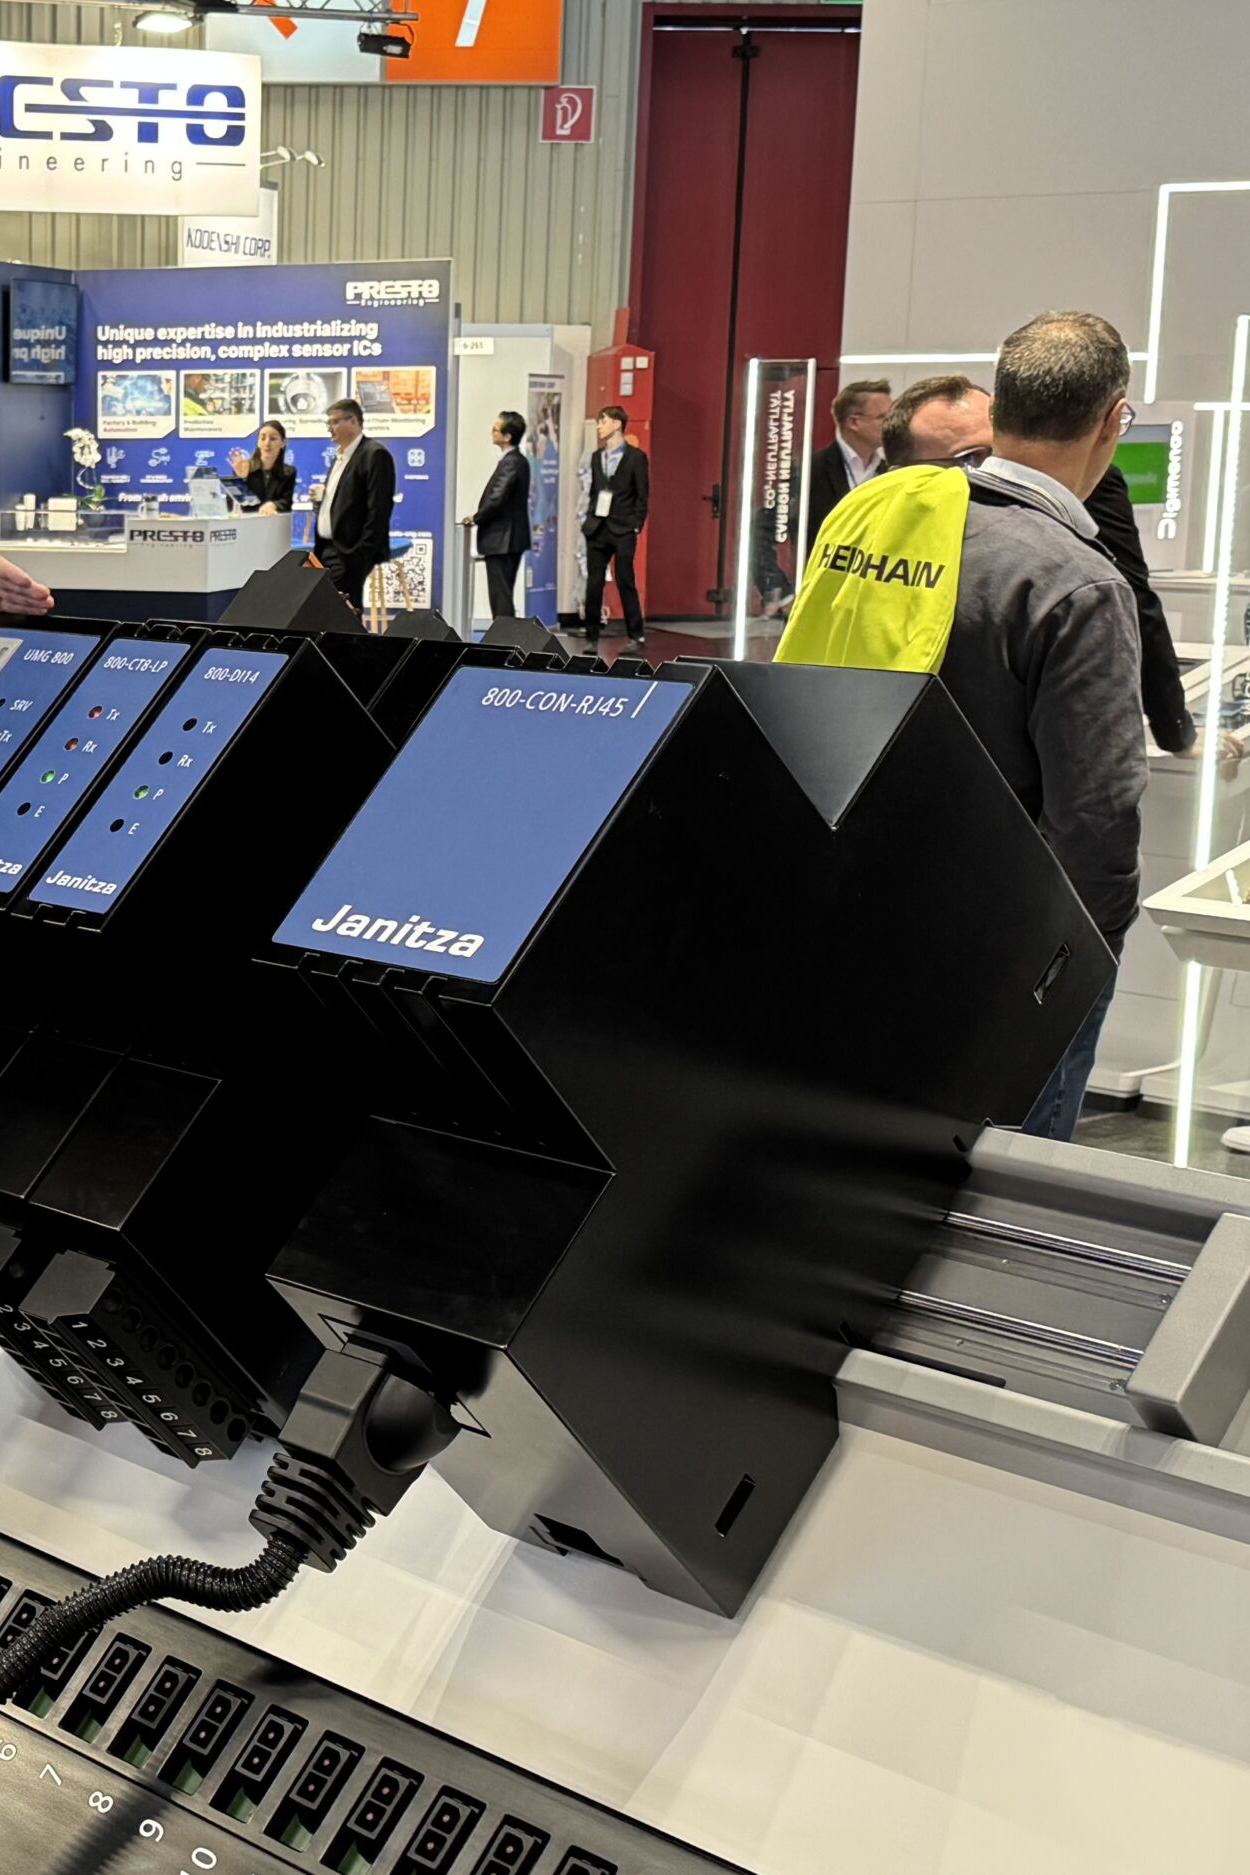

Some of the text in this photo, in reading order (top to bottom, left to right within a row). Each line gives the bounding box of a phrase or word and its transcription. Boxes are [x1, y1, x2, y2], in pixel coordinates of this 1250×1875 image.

[346, 279, 440, 300] PRESTO
[97, 319, 379, 344] Unique expertise in industrializing
[97, 340, 383, 364] high precision, complex sensor ICs
[129, 529, 205, 543] PRESTO
[23, 649, 75, 665] UMG 800
[204, 666, 261, 684] 800-DI14
[9, 699, 34, 712] SRV
[481, 687, 629, 717] 800-CON-RJ45
[106, 708, 121, 721] Tx
[202, 721, 217, 734] Tx
[82, 740, 98, 753] Rx
[177, 754, 194, 768] Rx
[58, 773, 70, 785] P
[152, 788, 164, 800] P
[34, 805, 46, 818] E
[128, 822, 140, 835] E
[46, 870, 118, 895] Janitza
[312, 904, 485, 958] Janitza
[13, 1321, 32, 1332] 3
[32, 1339, 50, 1350] 4
[49, 1357, 68, 1368] 5
[66, 1374, 85, 1385] 6
[83, 1391, 102, 1402] 7
[100, 1409, 118, 1420] 8
[71, 1320, 213, 1457] 1 2 3 4 5 6 7 8
[39, 1763, 62, 1786] 7
[88, 1790, 114, 1814] 8
[139, 1818, 164, 1842] 9
[180, 1847, 217, 1875] 0
